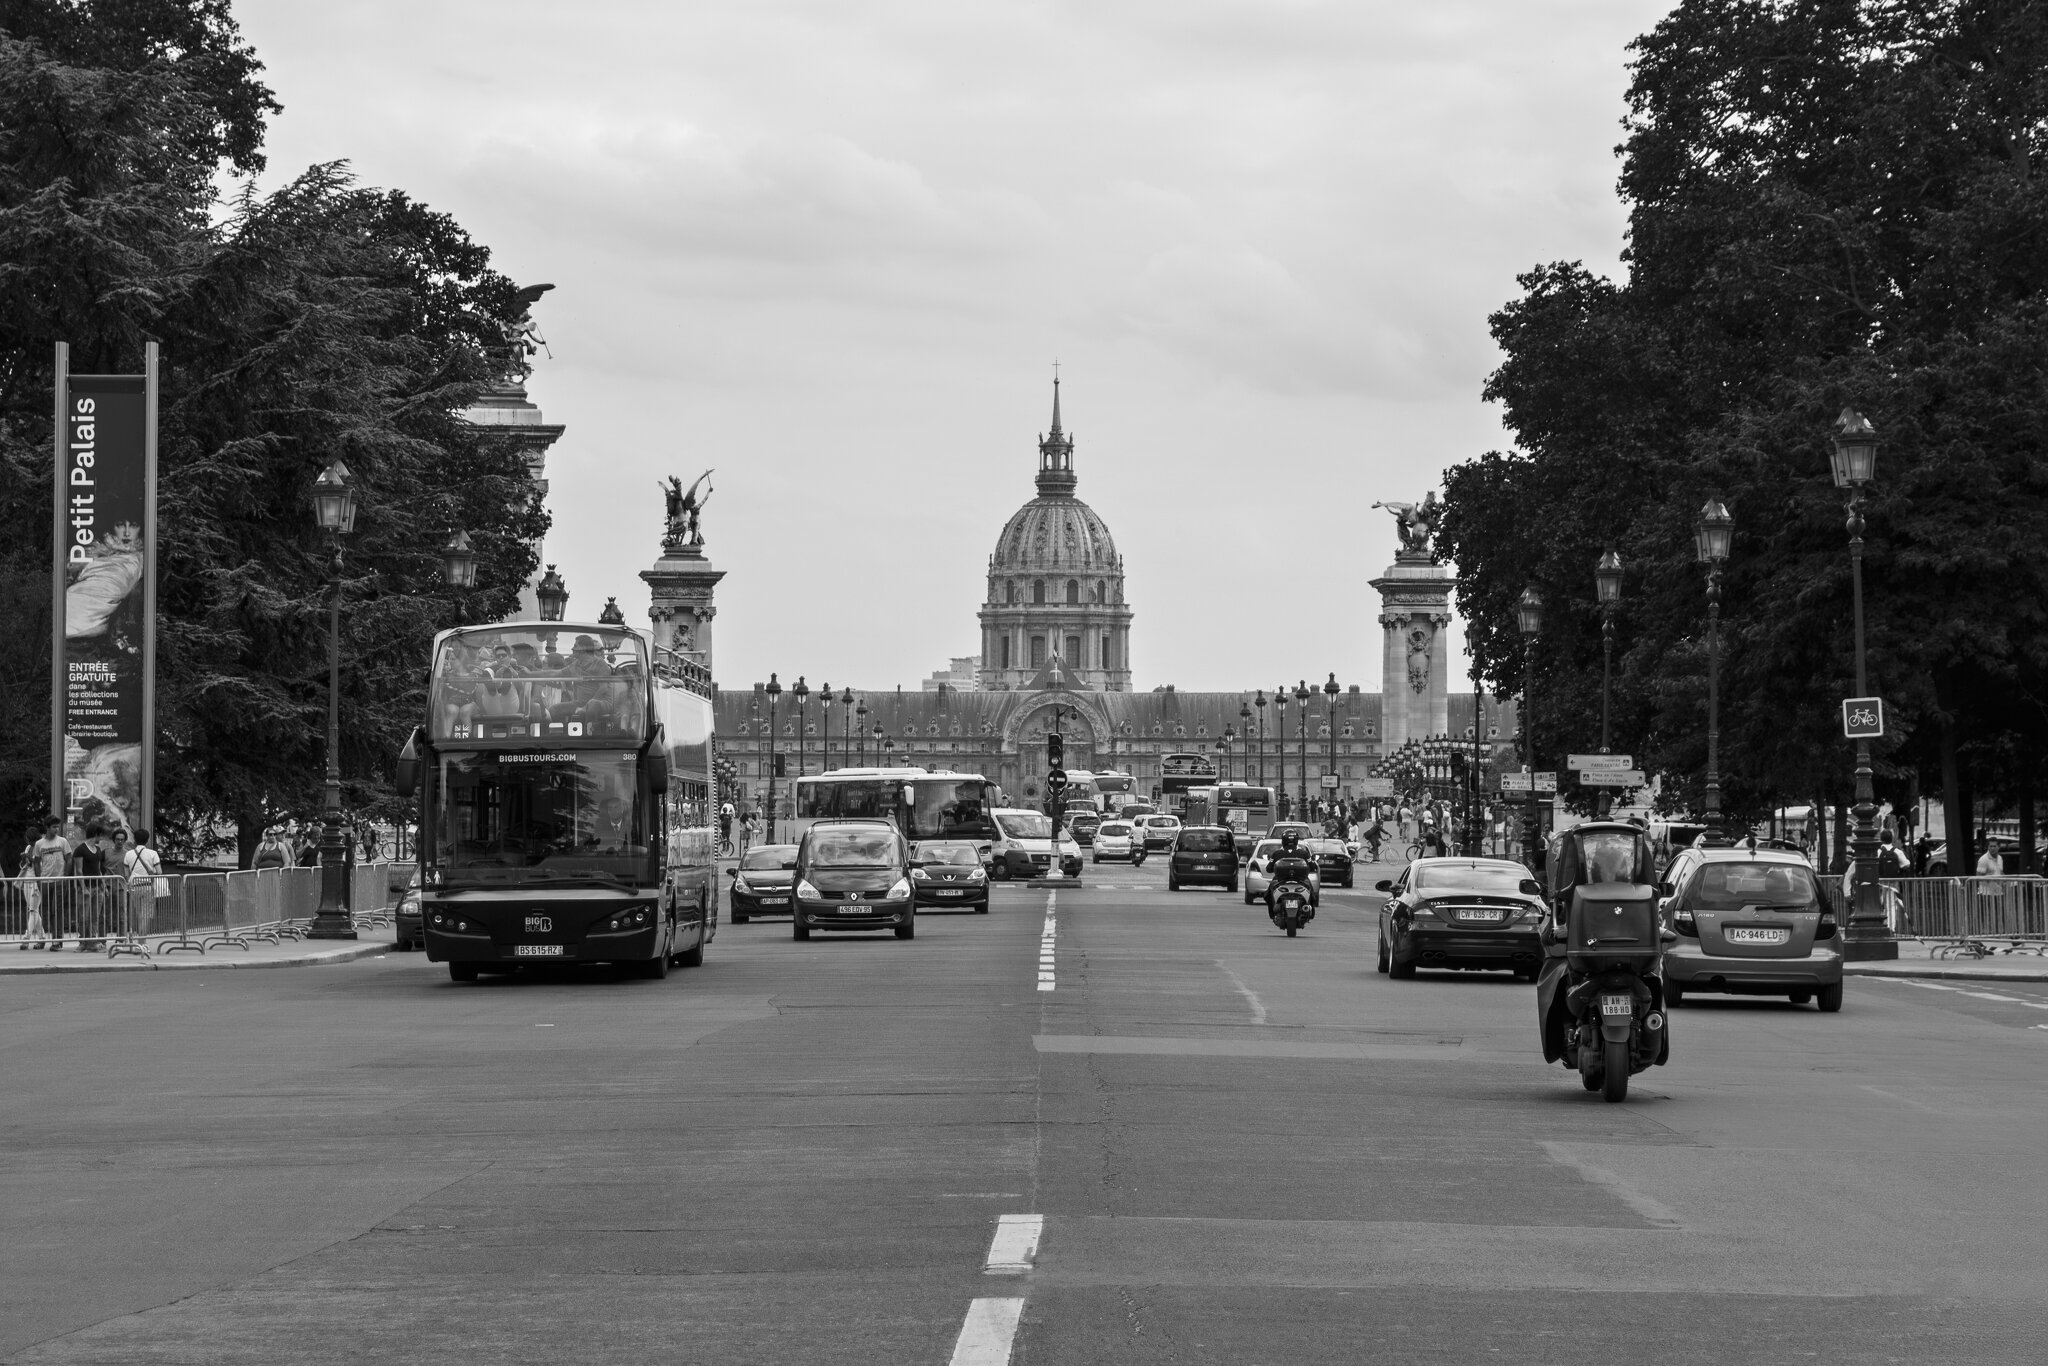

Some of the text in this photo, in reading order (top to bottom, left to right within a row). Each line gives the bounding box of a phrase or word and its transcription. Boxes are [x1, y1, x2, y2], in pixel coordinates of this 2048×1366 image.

[70, 398, 95, 563] Petit Palais
[69, 660, 109, 672] ENTRÉE
[69, 672, 117, 682] GRATUITE
[68, 682, 87, 690] dans
[68, 690, 119, 698] les collections
[499, 753, 637, 763] BIGBUSTOURS.COM 380
[525, 917, 540, 925] BIG
[525, 924, 541, 932] BUS
[1735, 930, 1778, 940] AC-946-LD
